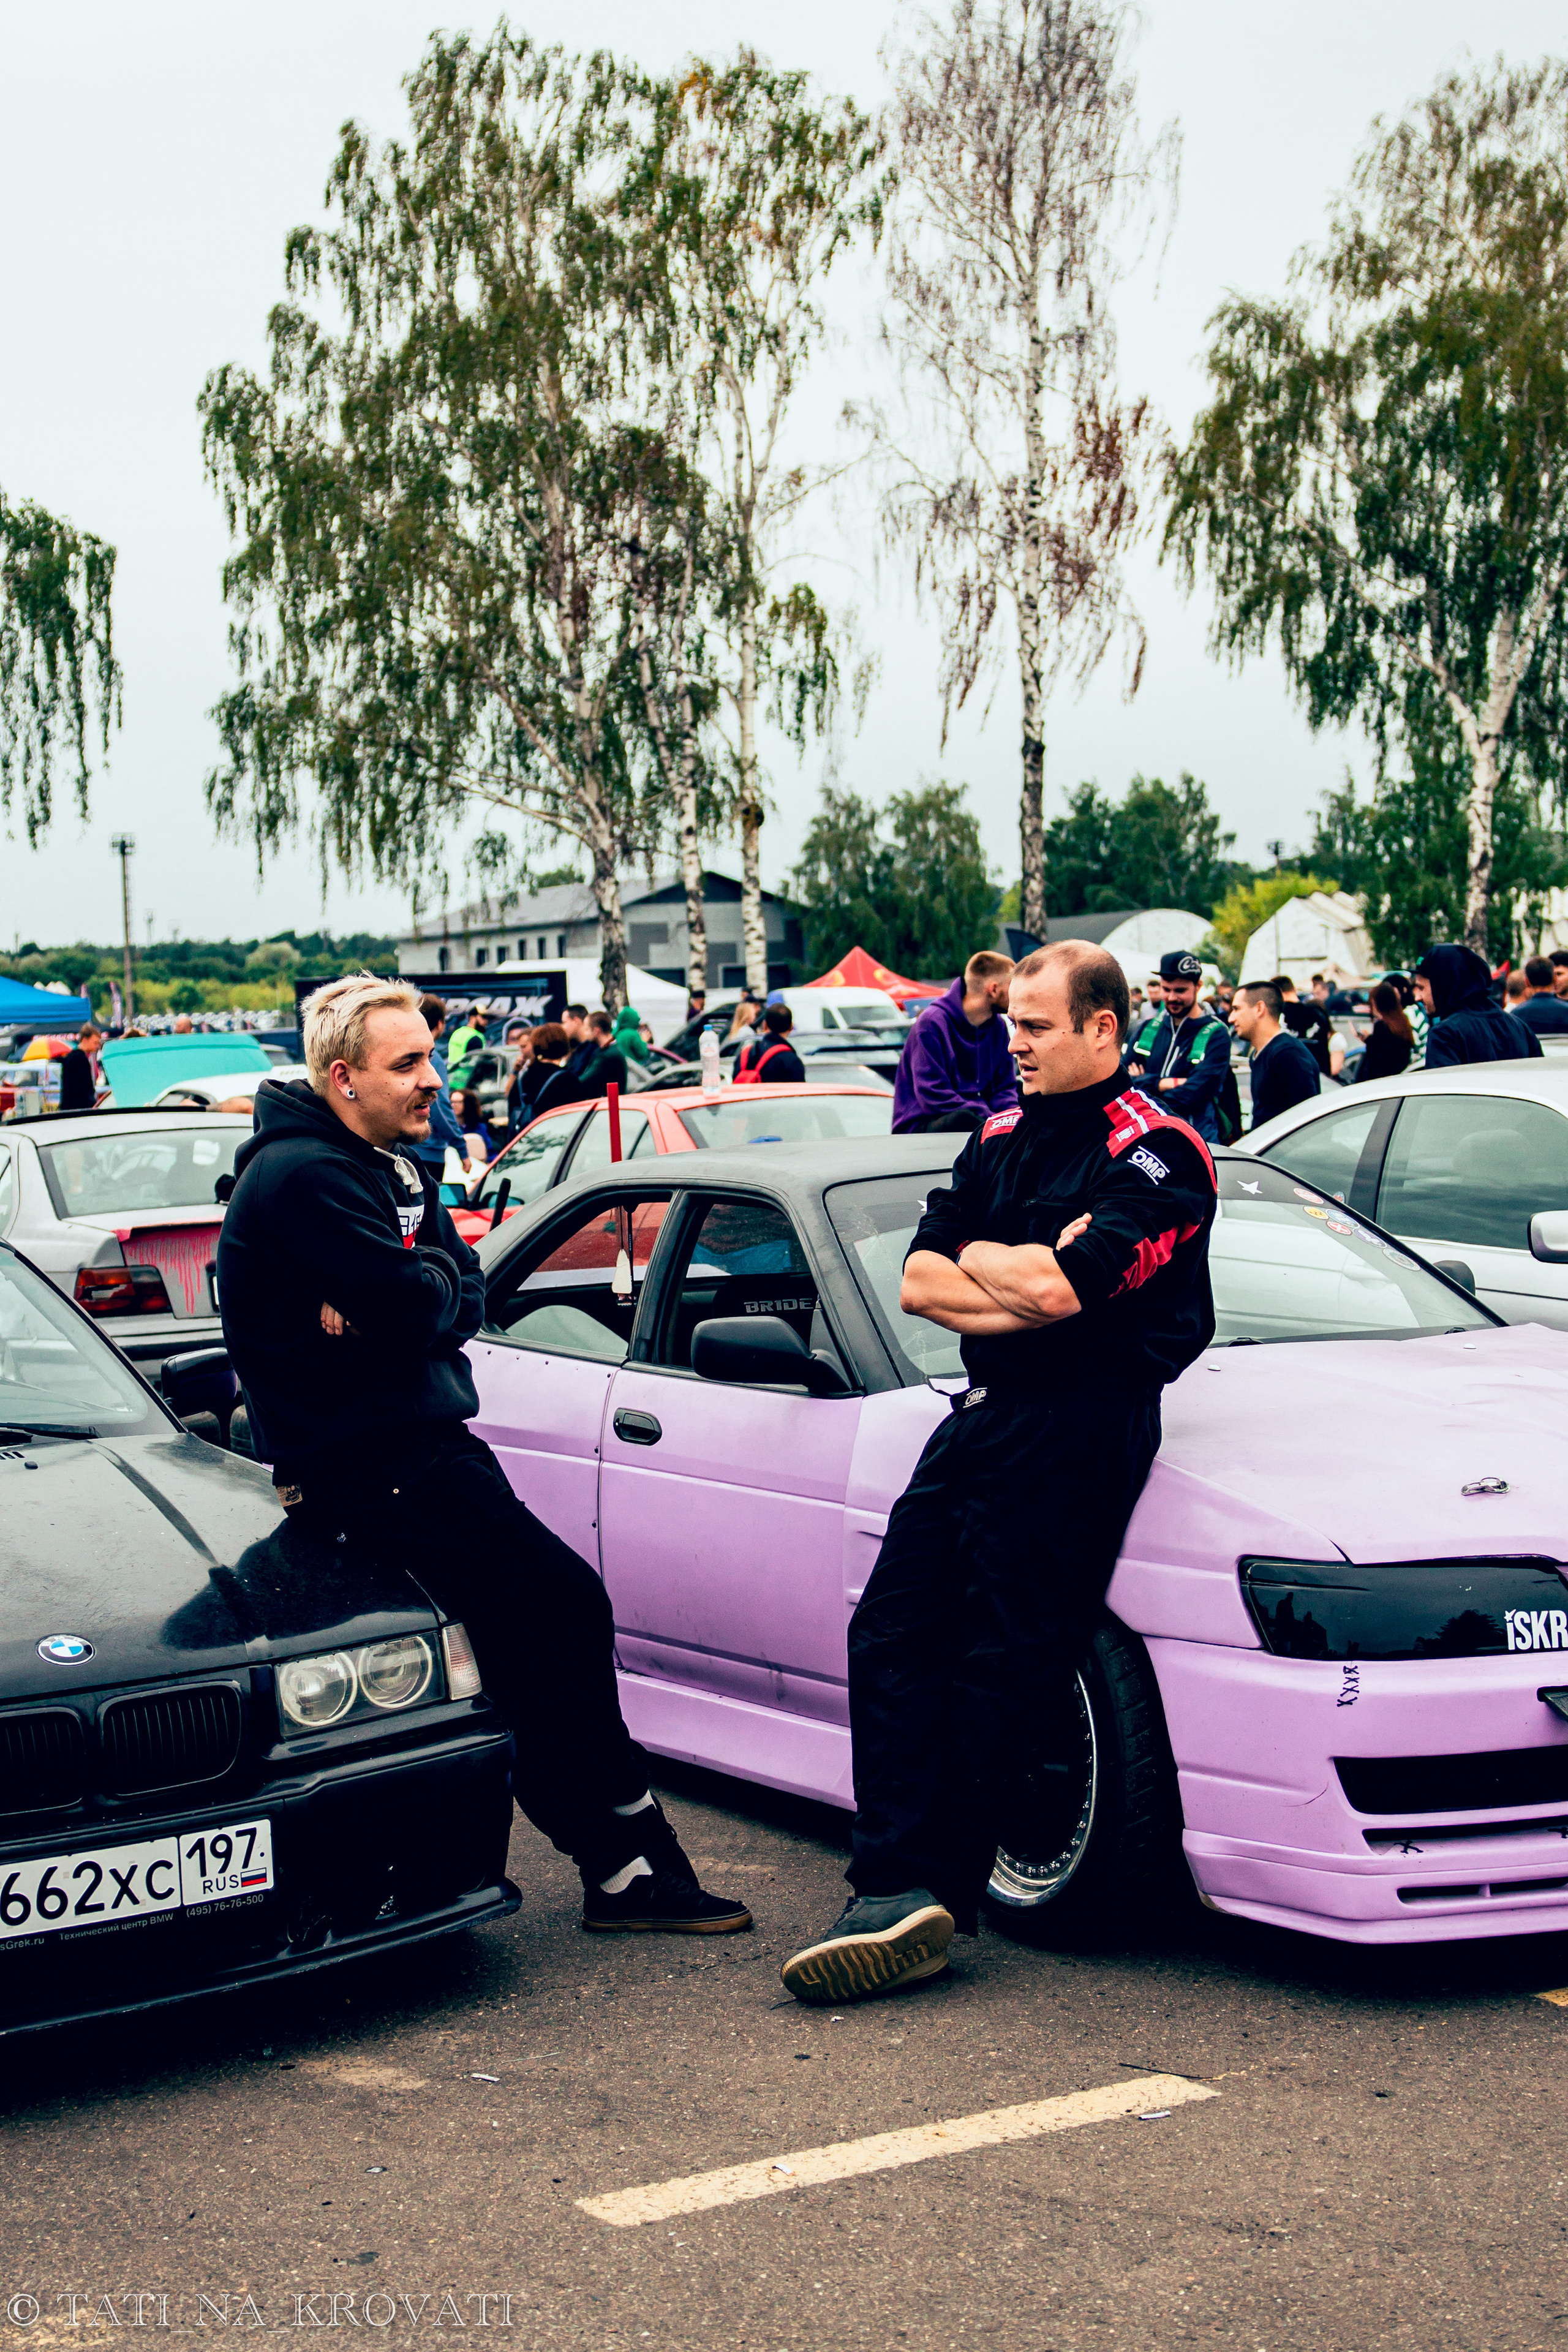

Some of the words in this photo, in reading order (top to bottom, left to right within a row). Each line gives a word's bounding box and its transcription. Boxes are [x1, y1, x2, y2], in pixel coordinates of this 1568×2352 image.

[1131, 1150, 1166, 1179] OMP
[744, 1298, 813, 1313] BRIDE
[965, 1390, 986, 1405] OMP
[186, 1827, 257, 1877] 197
[203, 1874, 239, 1894] RUS
[186, 1904, 211, 1917] (495)
[214, 1894, 263, 1911] 76-76-500
[59, 1924, 119, 1940] Технический
[121, 1919, 148, 1931] центр
[150, 1913, 174, 1925] BMW
